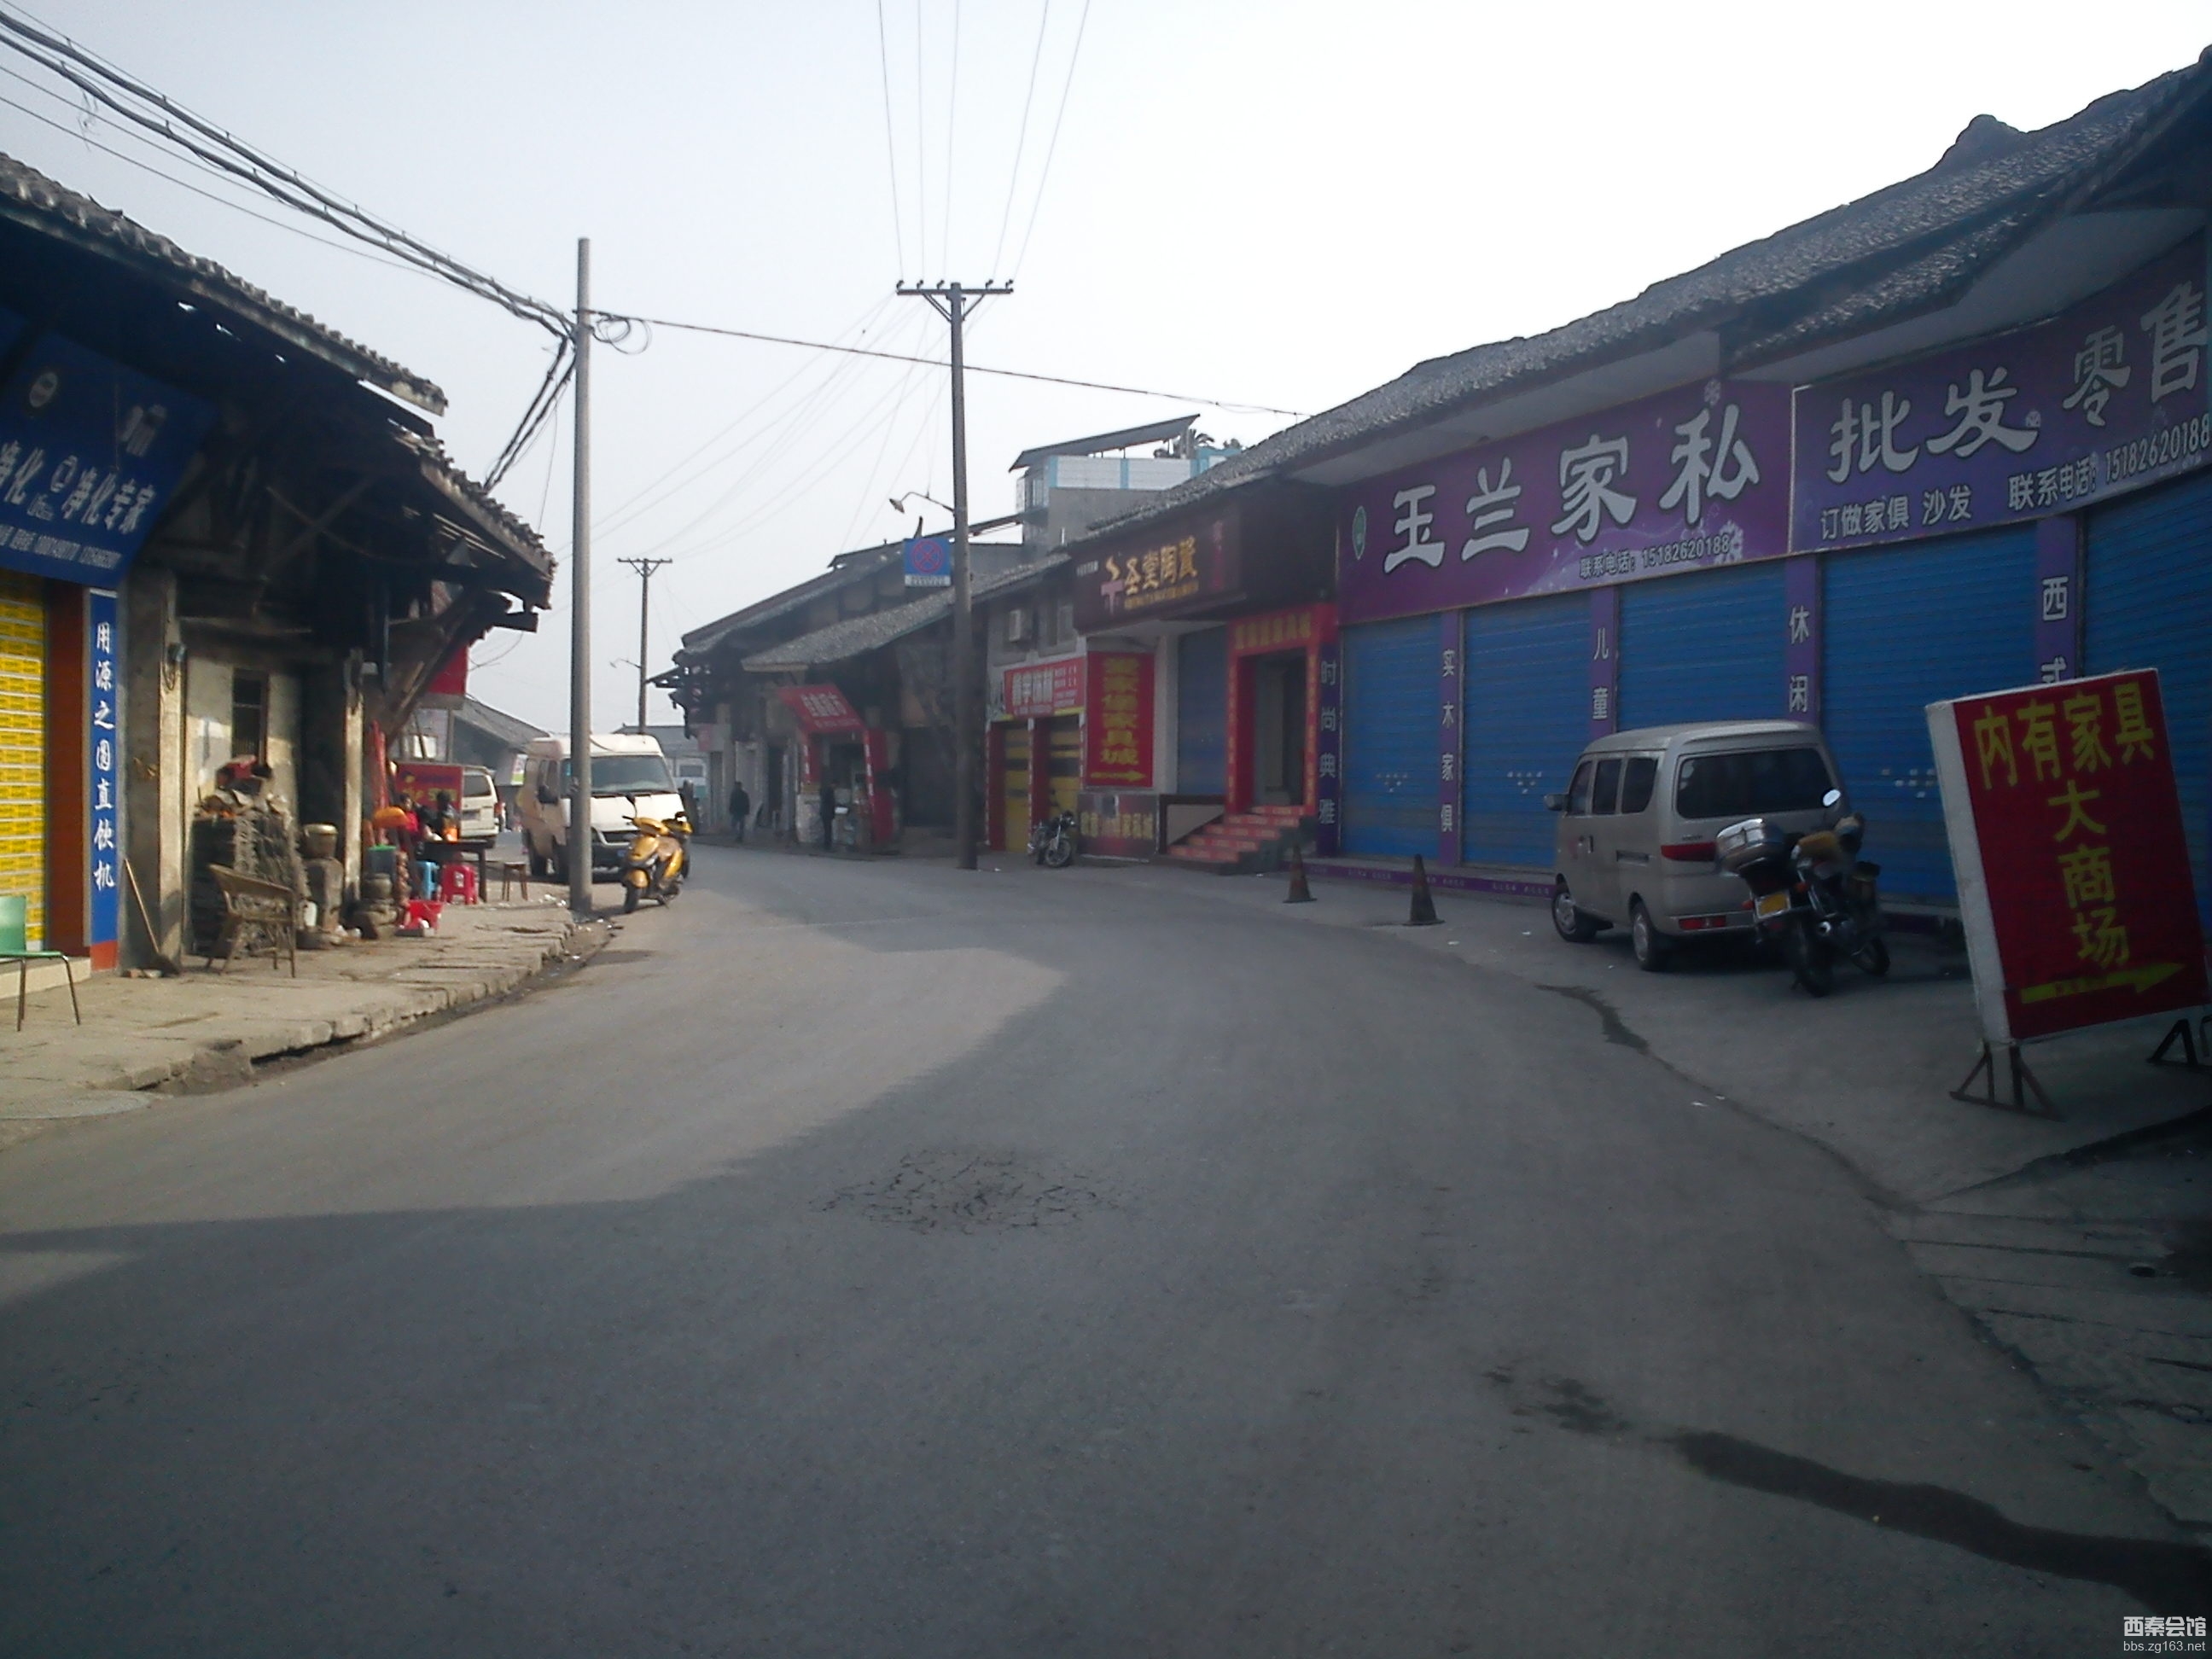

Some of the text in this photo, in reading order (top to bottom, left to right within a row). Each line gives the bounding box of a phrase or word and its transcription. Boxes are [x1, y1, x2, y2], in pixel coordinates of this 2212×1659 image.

[1382, 404, 1760, 573] 玉兰家私
[1922, 485, 1972, 525] 沙发
[1592, 627, 1609, 719] 儿童
[1789, 605, 1810, 713] 休闲
[1973, 682, 2156, 790] 内有家具
[2048, 779, 2131, 970] 大商场
